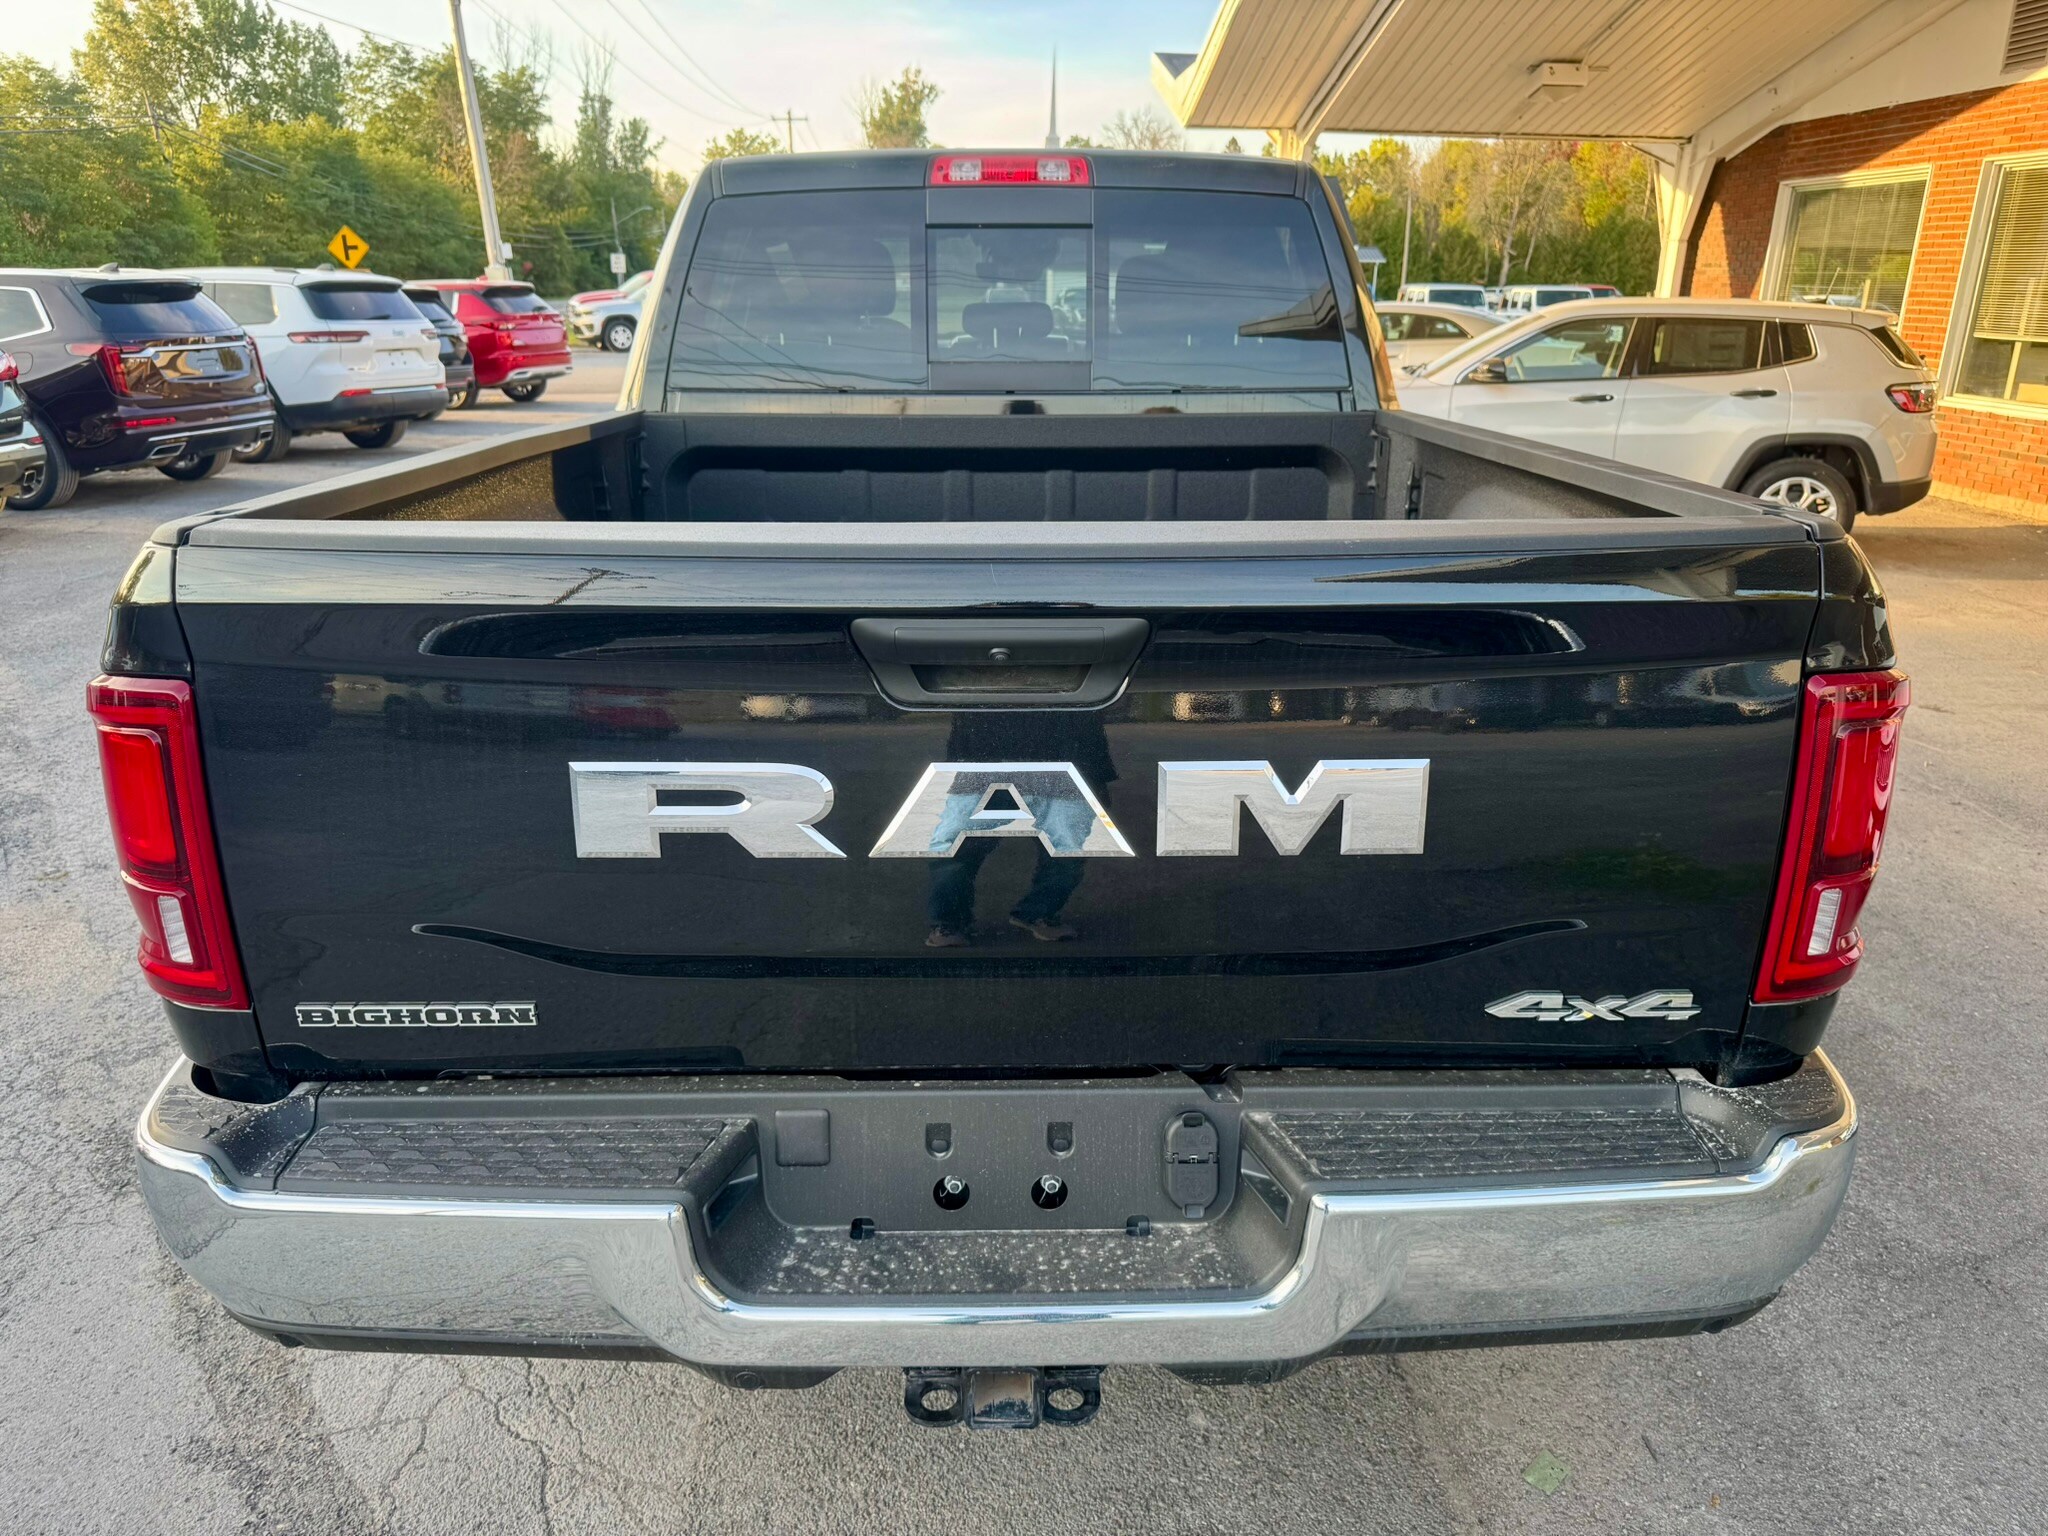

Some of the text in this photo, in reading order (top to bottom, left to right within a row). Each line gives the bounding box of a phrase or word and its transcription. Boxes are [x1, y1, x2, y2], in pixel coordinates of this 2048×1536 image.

[568, 758, 1431, 859] RAM
[295, 1001, 539, 1027] BIGHORN
[1485, 989, 1703, 1022] 4x4
